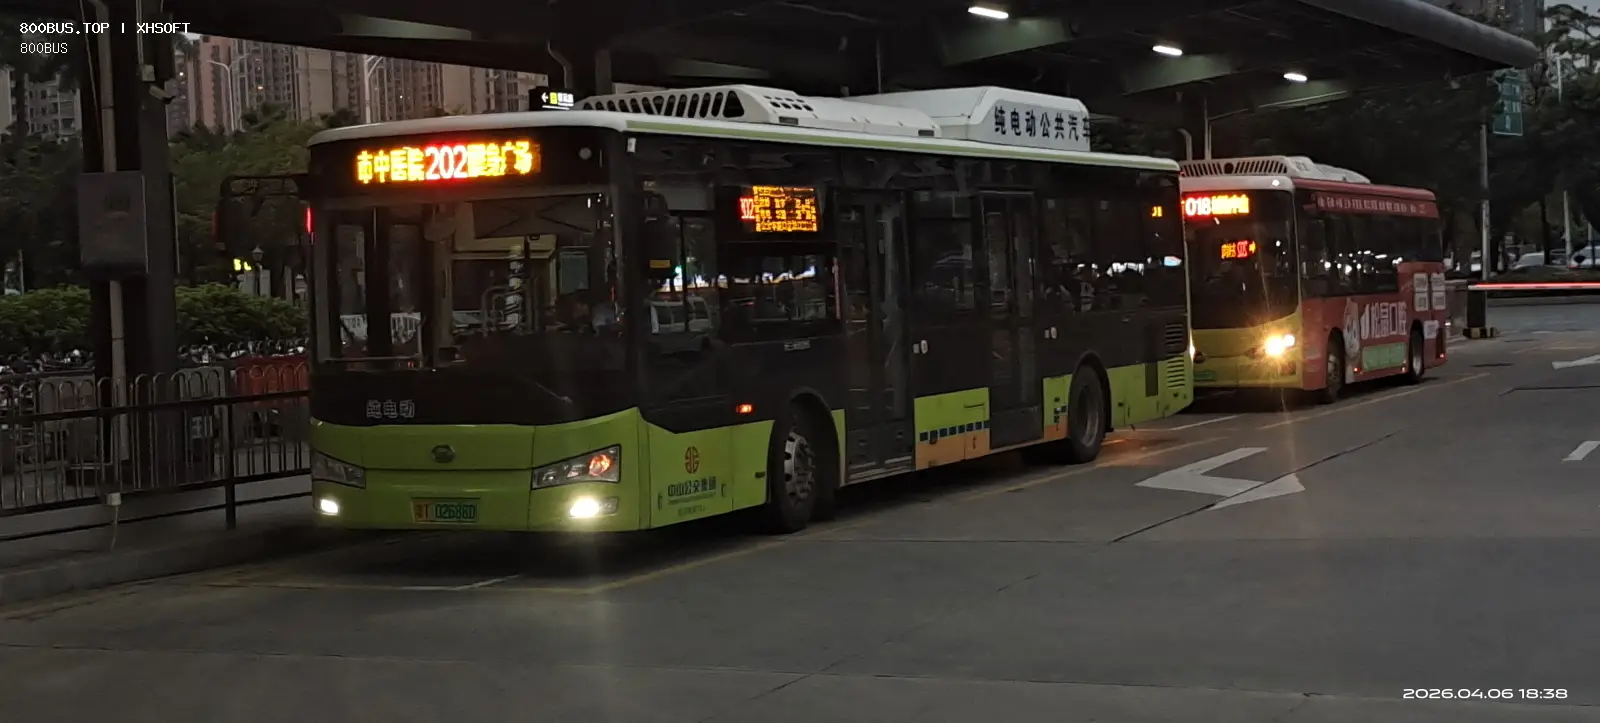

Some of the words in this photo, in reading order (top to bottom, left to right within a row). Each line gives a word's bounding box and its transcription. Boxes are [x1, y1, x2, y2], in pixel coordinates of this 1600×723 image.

[994, 106, 1091, 142] 纯电动公共汽车
[357, 146, 425, 184] 市中医院
[425, 144, 468, 180] 202
[1185, 197, 1211, 216] 018
[366, 398, 416, 419] 纯电动
